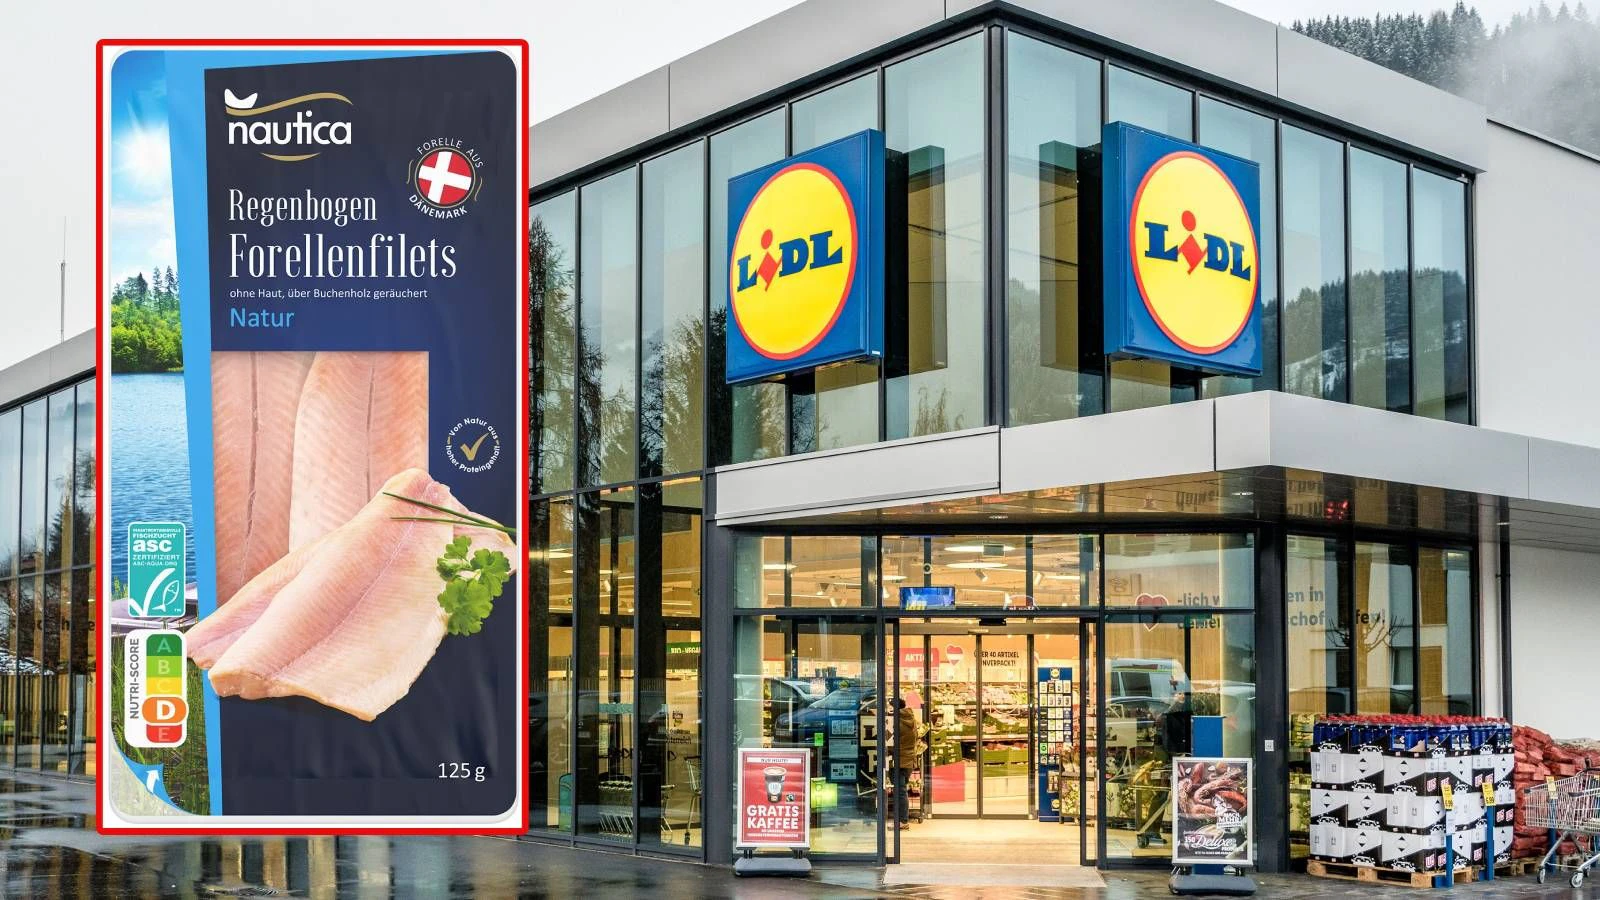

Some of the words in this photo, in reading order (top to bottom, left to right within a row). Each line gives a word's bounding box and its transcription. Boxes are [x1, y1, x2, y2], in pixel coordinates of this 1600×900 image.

[228, 110, 352, 145] nautica
[417, 137, 463, 155] FORELLE
[466, 148, 484, 168] AUS
[228, 188, 378, 227] Regenbogen
[409, 194, 468, 219] DÄNEMARK
[228, 233, 458, 278] Forellenfilets
[229, 289, 255, 298] ohne
[258, 289, 285, 299] Haut,
[287, 288, 311, 298] über
[313, 288, 371, 298] Buchenholz
[372, 288, 428, 300] geräuchert
[229, 307, 295, 328] Natur
[448, 423, 463, 436] Von
[463, 417, 488, 426] Natur
[487, 425, 499, 440] aus
[132, 539, 172, 553] asc
[157, 637, 172, 653] A
[158, 659, 170, 675] B
[981, 659, 1016, 667] NVERPACKT!
[129, 638, 140, 719] NUTRI-SCORE
[157, 679, 173, 693] C
[156, 700, 176, 720] D
[158, 727, 171, 741] E
[438, 762, 471, 779] 125
[475, 766, 486, 782] g
[746, 805, 799, 817] GRATIS
[747, 818, 799, 830] KAFFEE
